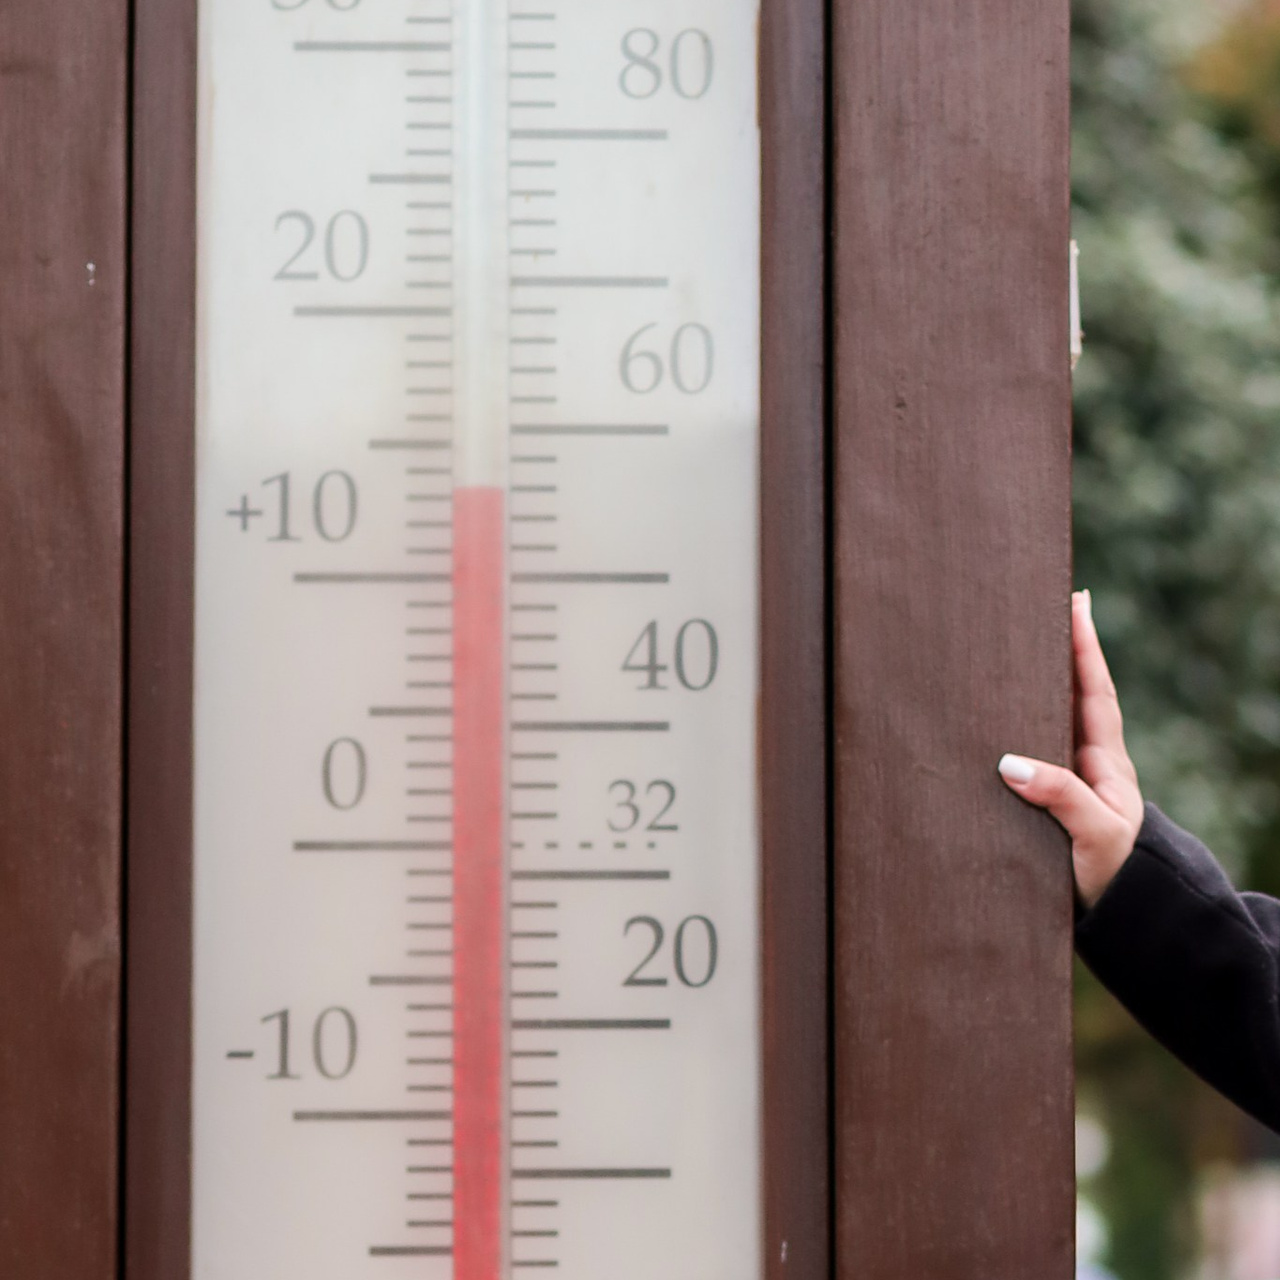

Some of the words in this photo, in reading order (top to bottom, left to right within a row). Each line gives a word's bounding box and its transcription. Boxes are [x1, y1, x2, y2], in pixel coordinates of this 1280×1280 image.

[617, 26, 715, 101] 80
[271, 208, 371, 284] 20
[617, 320, 716, 396] 60
[225, 470, 359, 543] +10
[620, 617, 720, 693] 40
[320, 736, 369, 811] 0
[607, 778, 680, 833] 32
[621, 914, 719, 989] 20
[225, 1006, 359, 1081] -10
